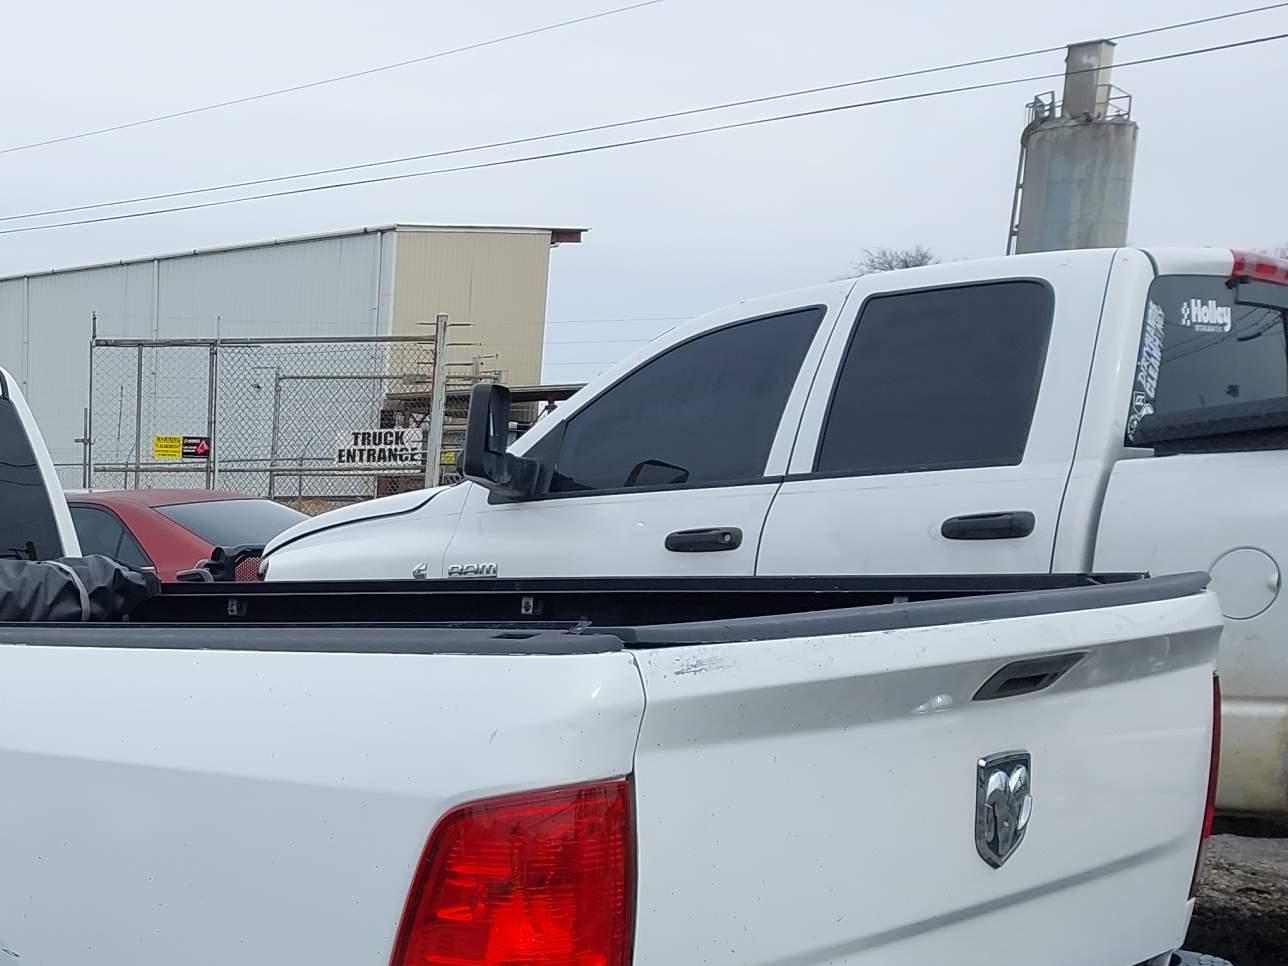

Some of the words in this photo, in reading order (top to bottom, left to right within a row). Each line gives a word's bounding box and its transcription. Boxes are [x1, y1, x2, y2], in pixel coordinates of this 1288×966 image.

[1190, 298, 1232, 332] Holley
[352, 431, 406, 446] TRUCK
[338, 447, 419, 463] ENTRANCE
